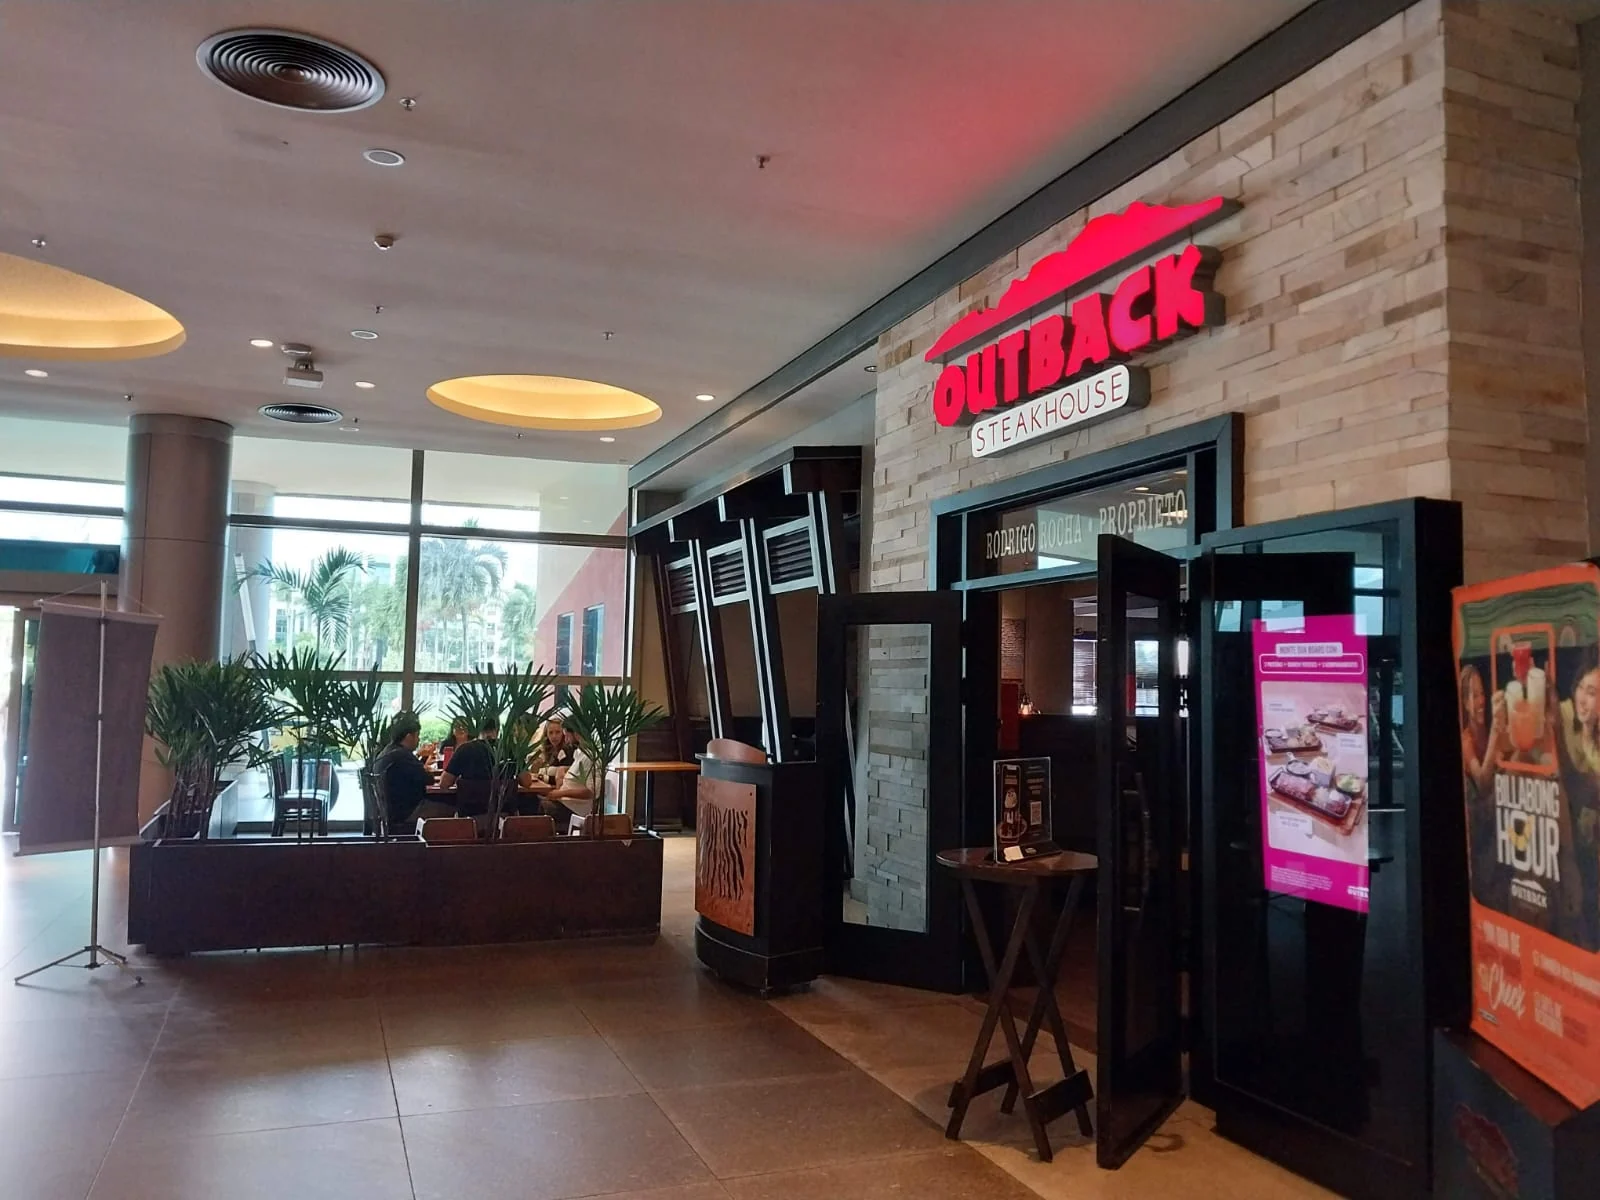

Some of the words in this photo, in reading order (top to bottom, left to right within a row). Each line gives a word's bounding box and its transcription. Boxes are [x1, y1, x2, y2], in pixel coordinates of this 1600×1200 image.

[933, 244, 1206, 427] OUTBACK
[975, 371, 1126, 453] STEAKHOUSE
[985, 522, 1036, 560] RODRIGO
[1038, 513, 1082, 550] ROCHA
[1495, 773, 1560, 818] BILLABONG
[1496, 806, 1560, 883] HOUR
[1511, 884, 1547, 909] OUTBACK
